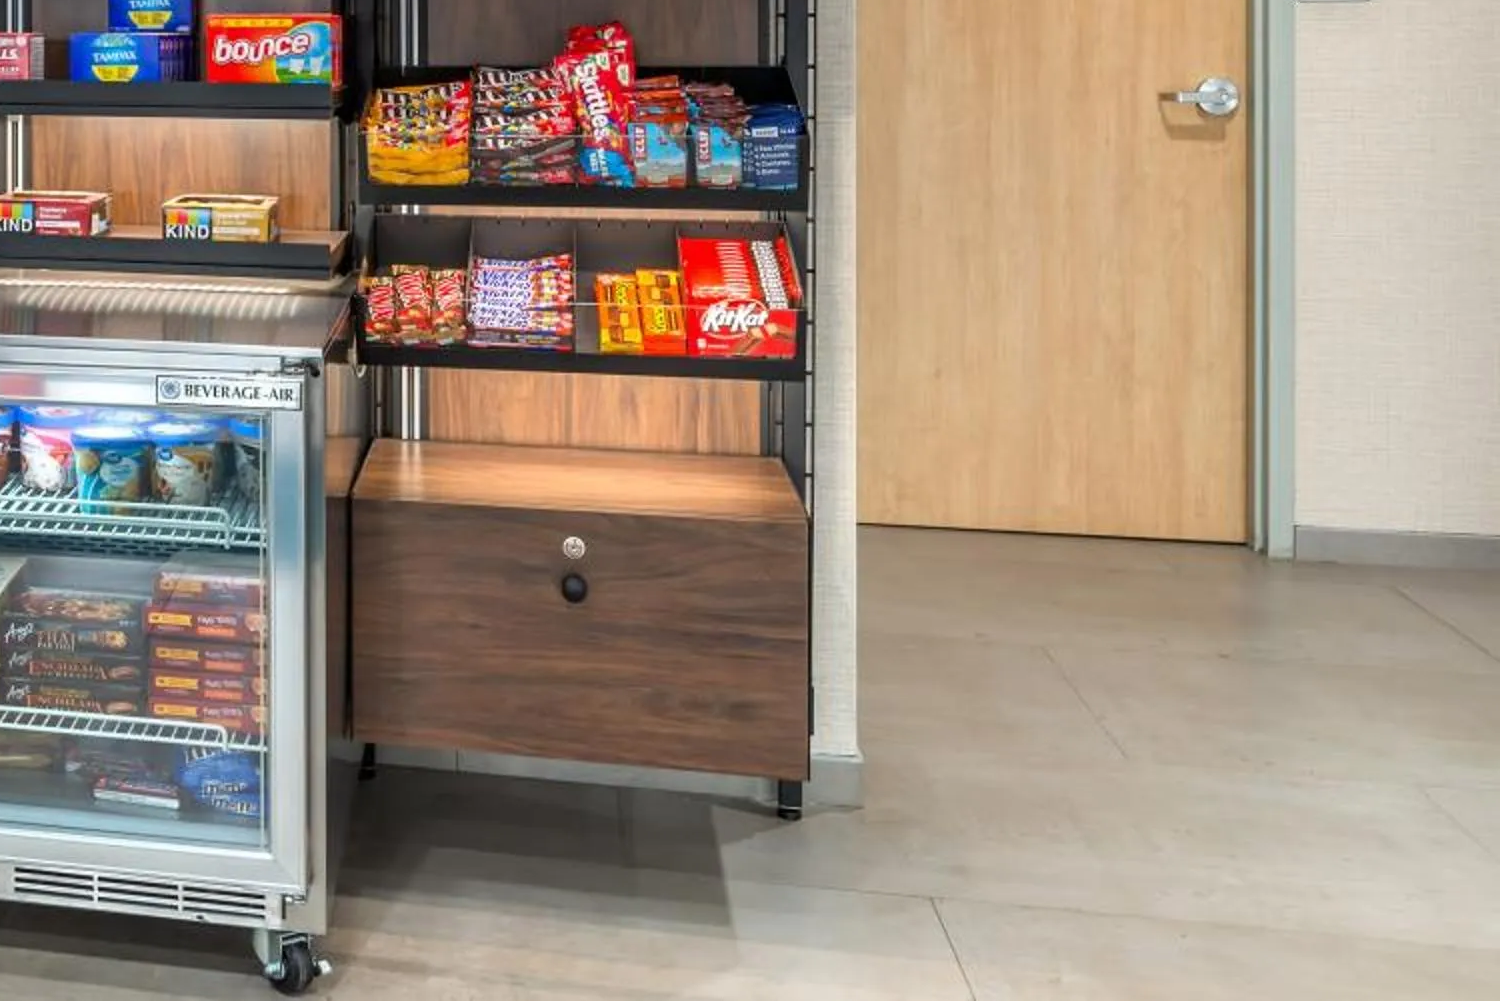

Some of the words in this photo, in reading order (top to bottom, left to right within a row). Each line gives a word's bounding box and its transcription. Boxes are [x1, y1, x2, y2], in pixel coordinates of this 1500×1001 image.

[92, 50, 138, 63] TAMPAX
[214, 32, 311, 66] bounce
[575, 62, 611, 142] Skittles
[164, 223, 210, 241] KIND
[184, 383, 294, 402] BEVERAGE-AIR
